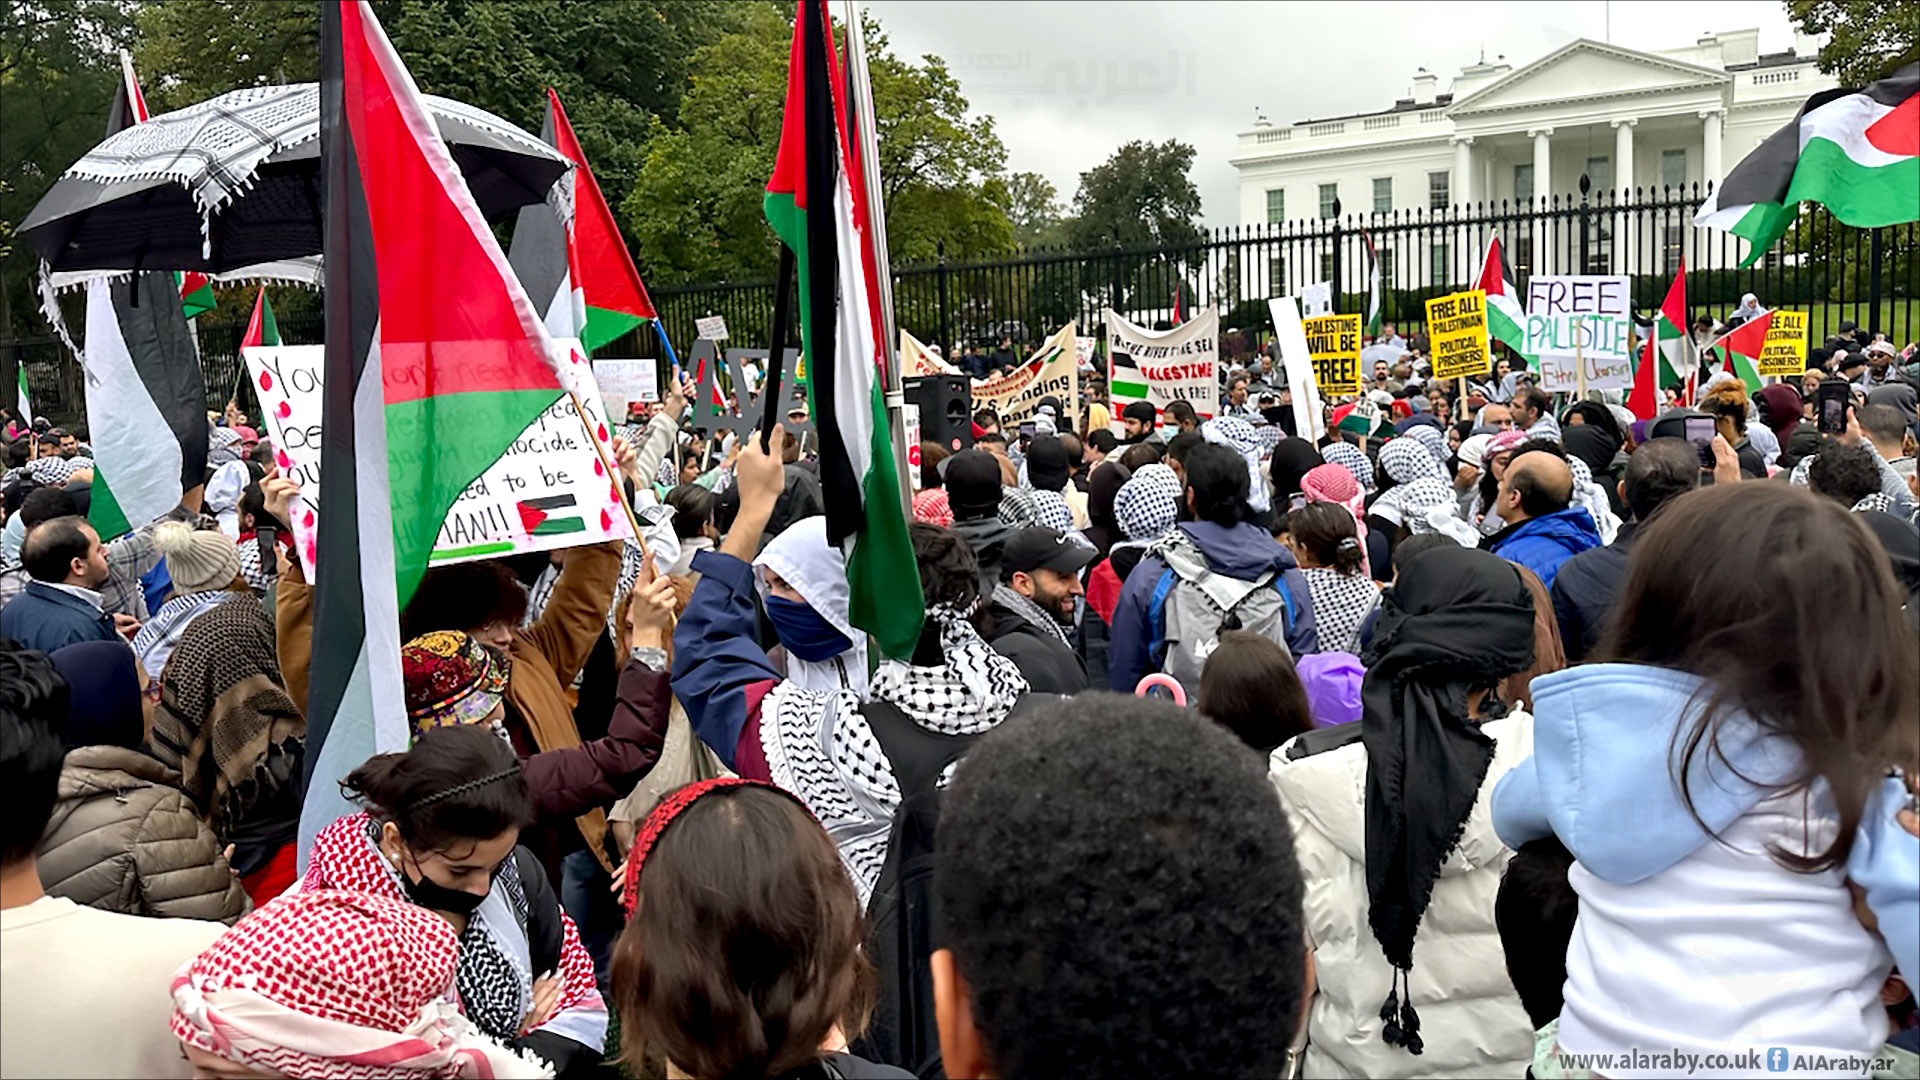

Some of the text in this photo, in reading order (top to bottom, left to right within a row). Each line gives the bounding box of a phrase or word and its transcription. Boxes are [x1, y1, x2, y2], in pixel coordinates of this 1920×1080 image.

[1430, 296, 1482, 321] FREE ALL
[1529, 281, 1623, 316] FREE
[1305, 317, 1357, 336] PALESTINE
[1432, 314, 1483, 335] PALESTINIAN
[1771, 316, 1803, 329] EE ALL
[1195, 338, 1213, 353] SEA
[1306, 334, 1356, 354] WILL BE
[1440, 336, 1478, 354] POLITICAL
[1766, 330, 1803, 341] LESTINIAN
[1437, 349, 1485, 369] PRISONERS!
[1763, 346, 1796, 356] OLITICAL
[1141, 362, 1213, 381] PALESTINE
[1311, 358, 1357, 385] FREE!
[1541, 360, 1577, 388] Ethni
[273, 410, 323, 451] be
[503, 473, 526, 493] to
[539, 465, 575, 488] be
